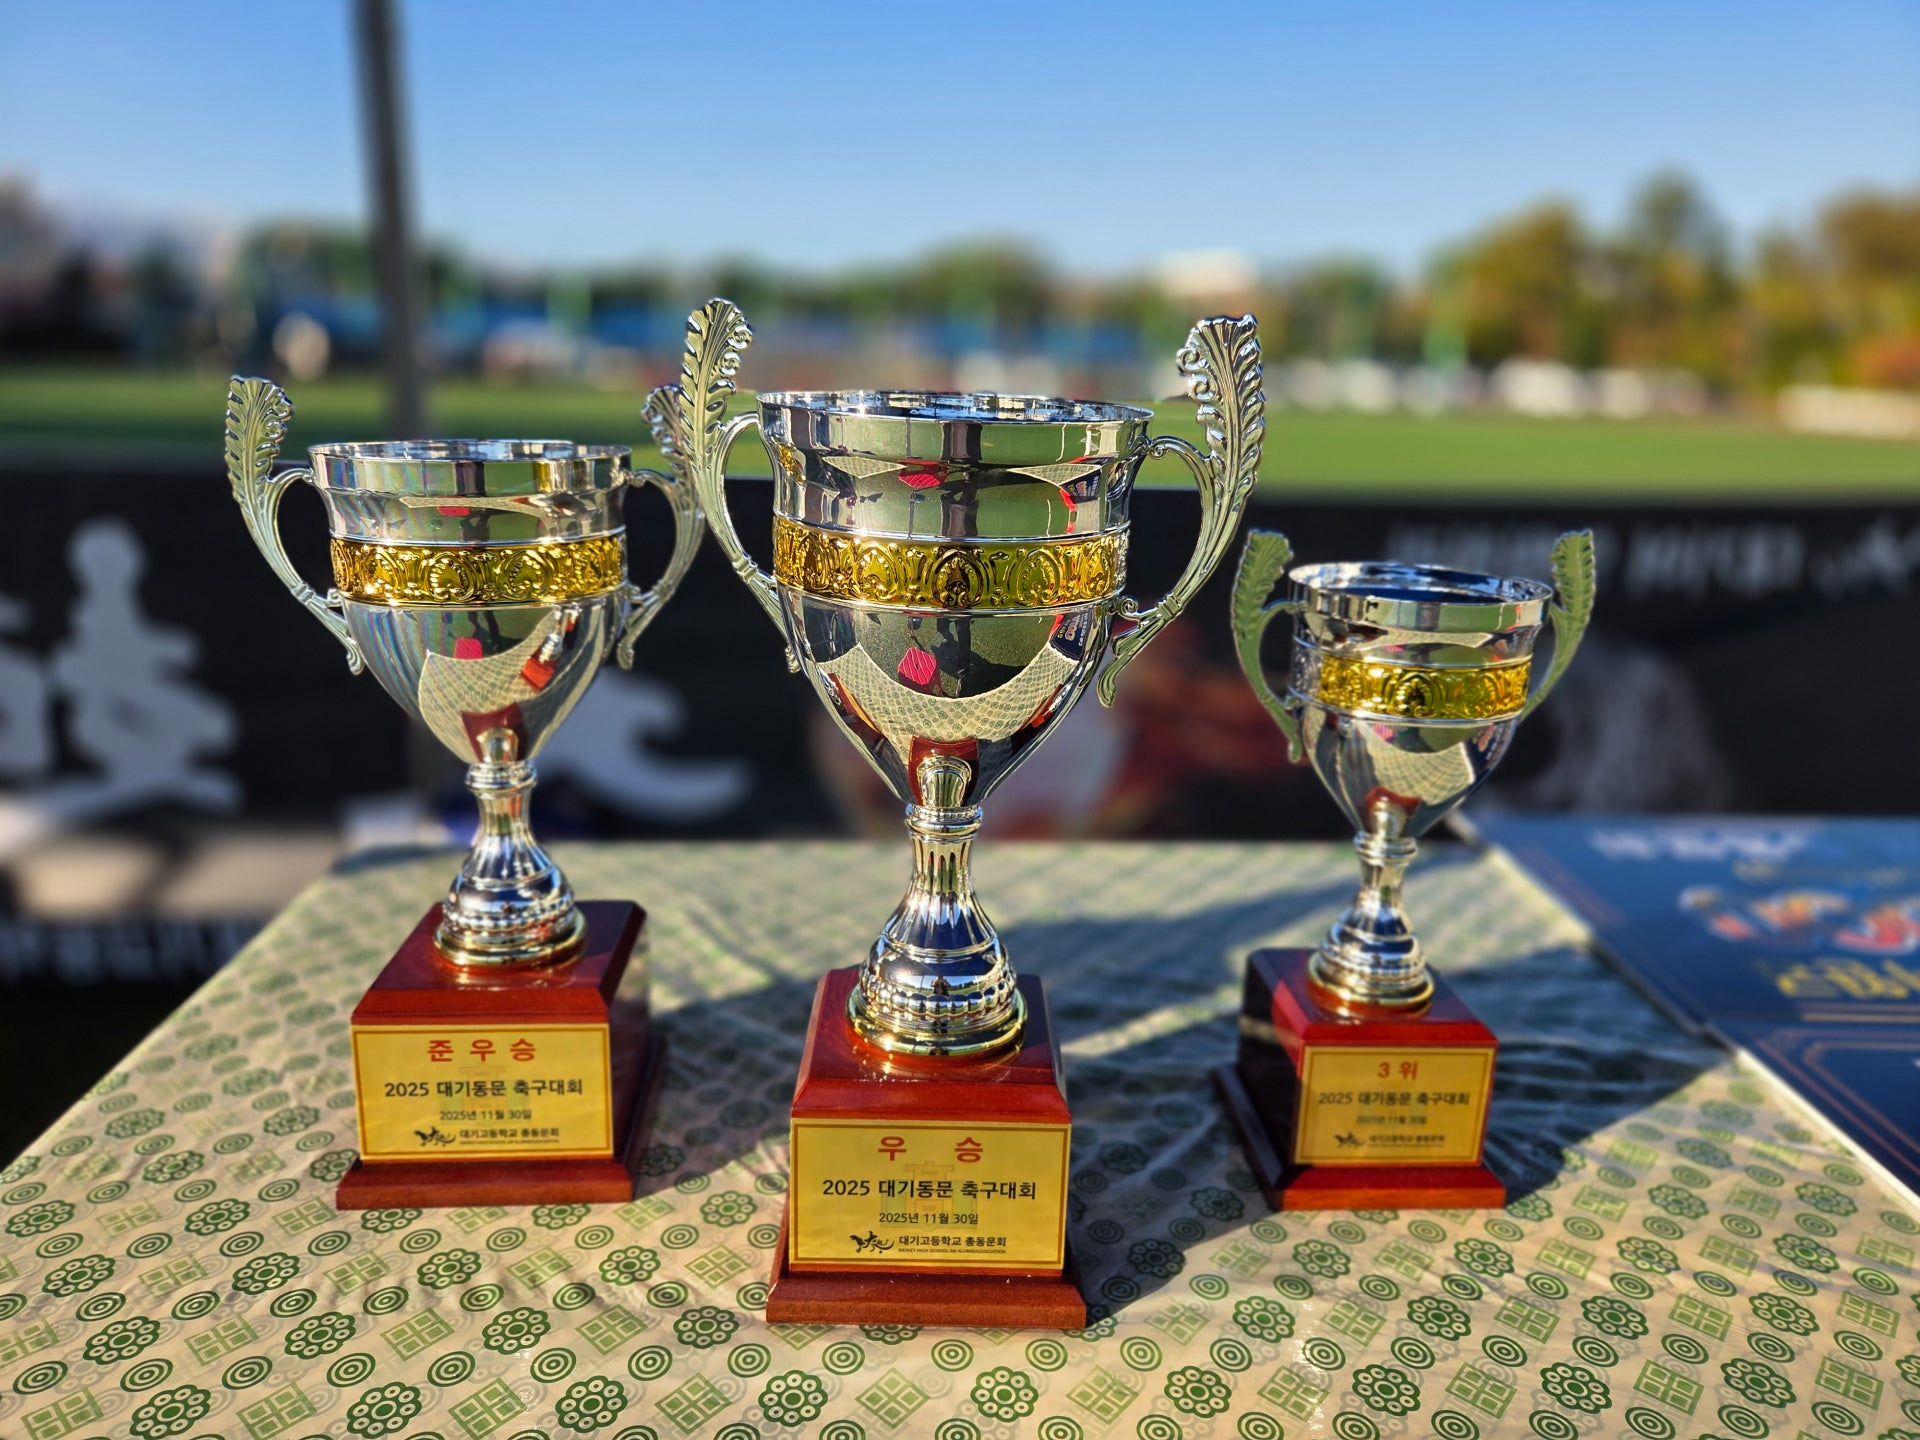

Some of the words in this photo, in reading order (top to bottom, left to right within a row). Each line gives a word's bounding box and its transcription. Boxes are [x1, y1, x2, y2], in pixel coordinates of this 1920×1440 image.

[427, 1039, 454, 1062] 준
[470, 1039, 496, 1062] 우
[509, 1037, 536, 1062] 승
[1378, 1061, 1390, 1078] 3
[1398, 1060, 1419, 1080] 위
[385, 1081, 429, 1098] 2025
[437, 1079, 507, 1098] 대기동문
[513, 1078, 583, 1097] 축구대회
[1318, 1092, 1352, 1105] 2025
[1358, 1092, 1412, 1106] 대기동문
[1417, 1092, 1470, 1106] 축구대회
[439, 1110, 477, 1121] 2025년
[481, 1109, 505, 1121] 11월
[508, 1109, 532, 1120] 30일
[459, 1128, 518, 1139] 대기고등학교
[878, 1135, 907, 1161] 우
[954, 1136, 983, 1163] 승
[822, 1179, 870, 1196] 2025
[878, 1179, 953, 1199] 대기동문
[960, 1180, 1036, 1200] 축구대회
[879, 1212, 919, 1224] 2025년
[923, 1212, 949, 1225] 11월
[953, 1212, 979, 1225] 30일
[899, 1235, 962, 1247] 대기고등학교
[965, 1235, 1006, 1247] 총동문회
